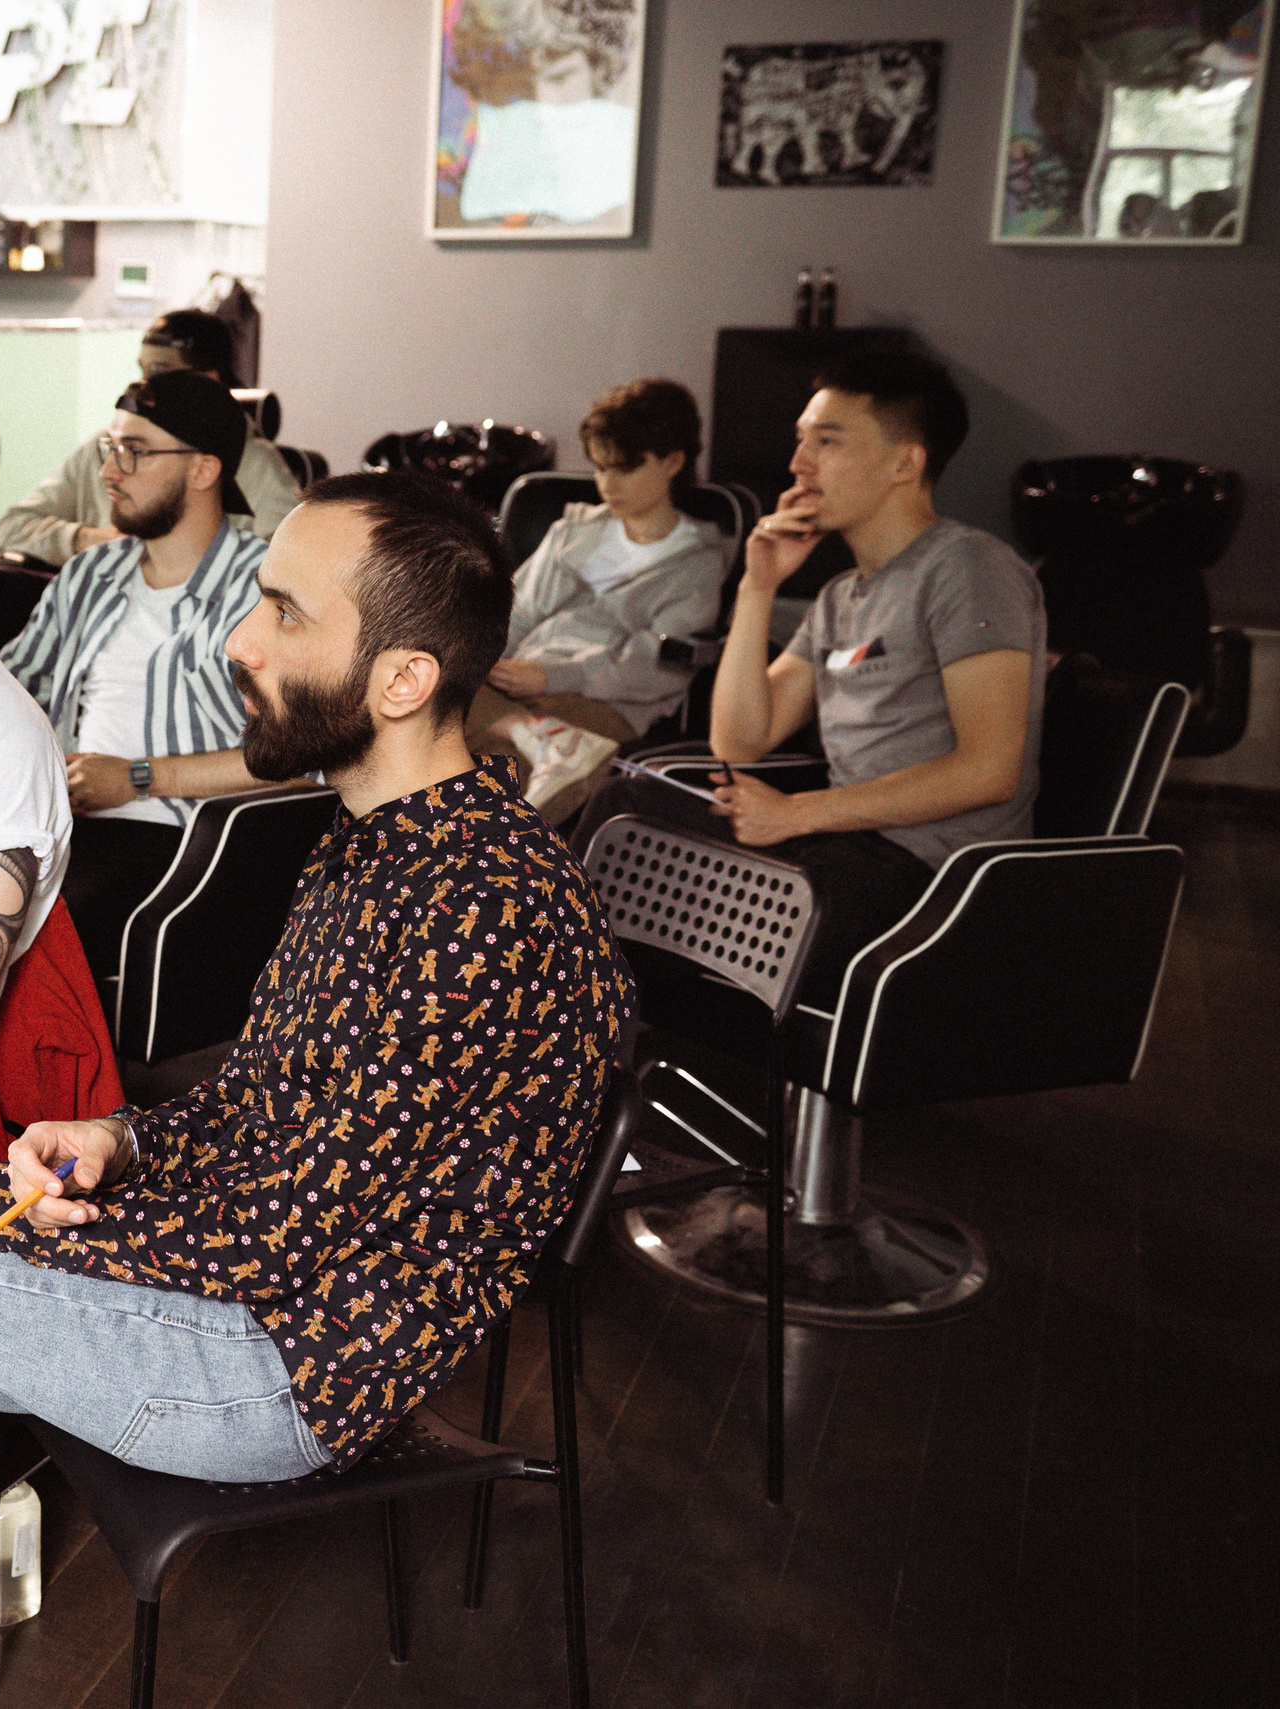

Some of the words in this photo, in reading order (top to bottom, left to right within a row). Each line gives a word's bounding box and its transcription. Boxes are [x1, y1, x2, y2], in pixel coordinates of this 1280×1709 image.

[446, 992, 469, 1001] XMAS
[521, 1028, 539, 1036] XMAS
[446, 1075, 459, 1093] XMAS
[506, 1101, 521, 1119] XMAS
[359, 1113, 376, 1127] XMAS
[331, 1315, 349, 1331] XMAS
